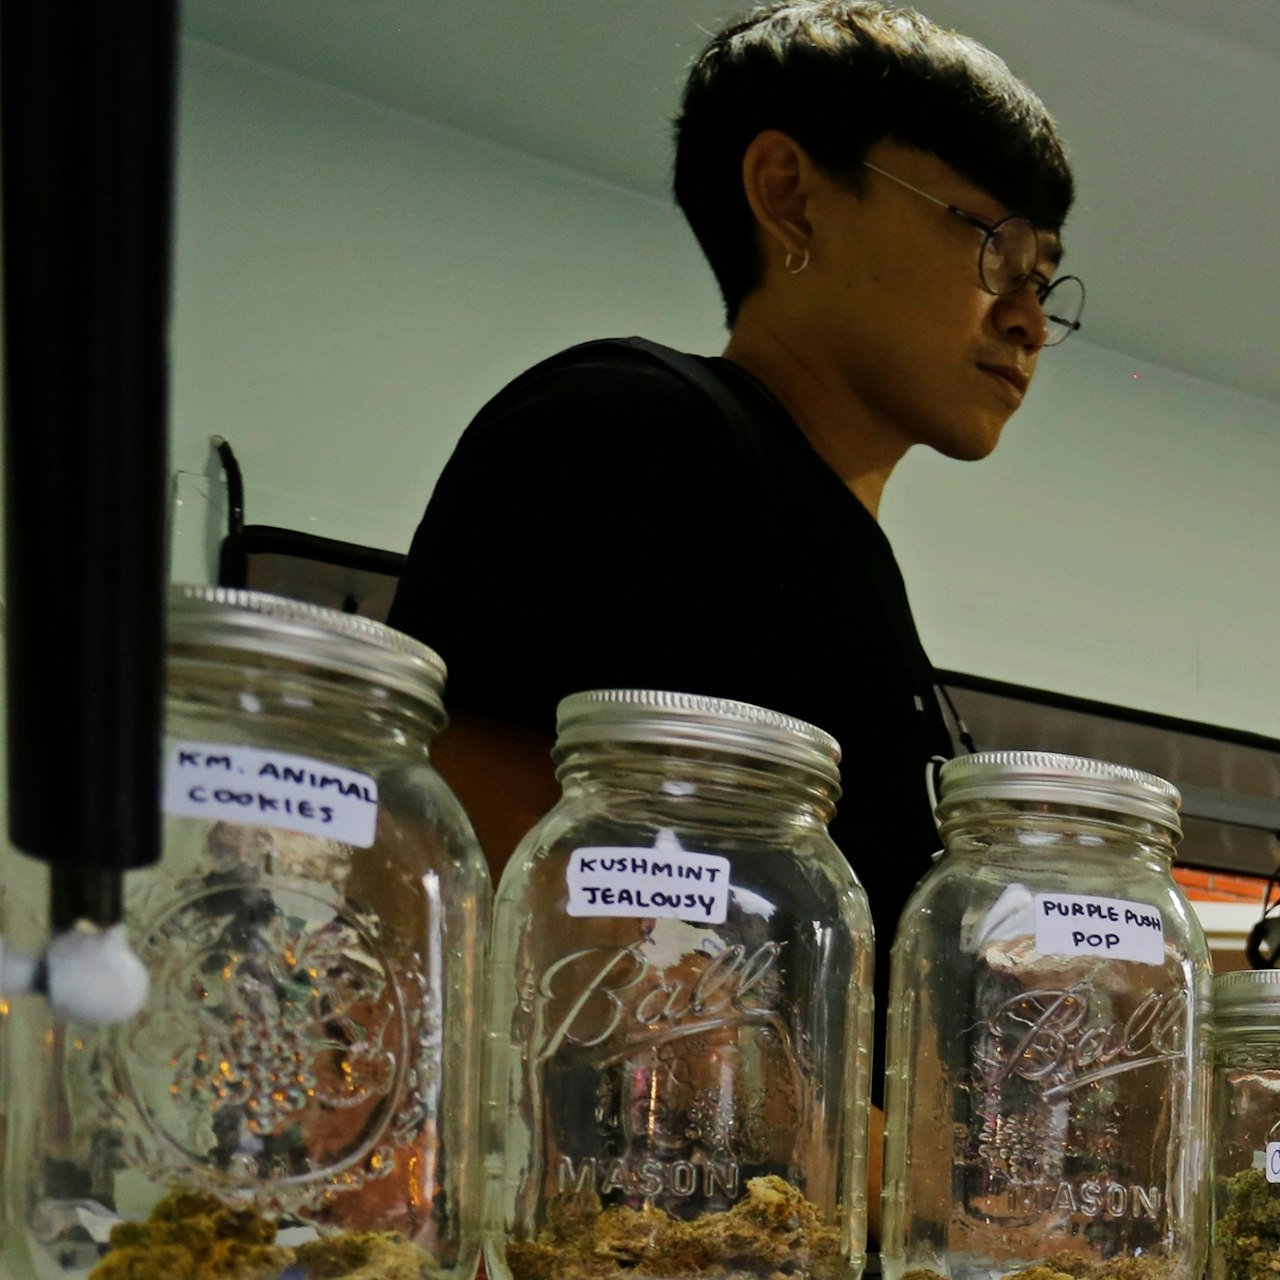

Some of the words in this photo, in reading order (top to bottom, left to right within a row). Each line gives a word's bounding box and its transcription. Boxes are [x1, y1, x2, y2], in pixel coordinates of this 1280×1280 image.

[178, 751, 244, 775] KM.
[258, 763, 378, 804] ANIMAL
[189, 786, 334, 823] COOKIES
[579, 857, 721, 883] KUSHMINT
[582, 886, 716, 916] JEALOUSY
[1043, 900, 1120, 924] PURPLE
[1124, 908, 1162, 932] PUSH
[1071, 930, 1121, 950] POP
[538, 940, 790, 1064] Ball
[557, 1156, 740, 1199] MASON
